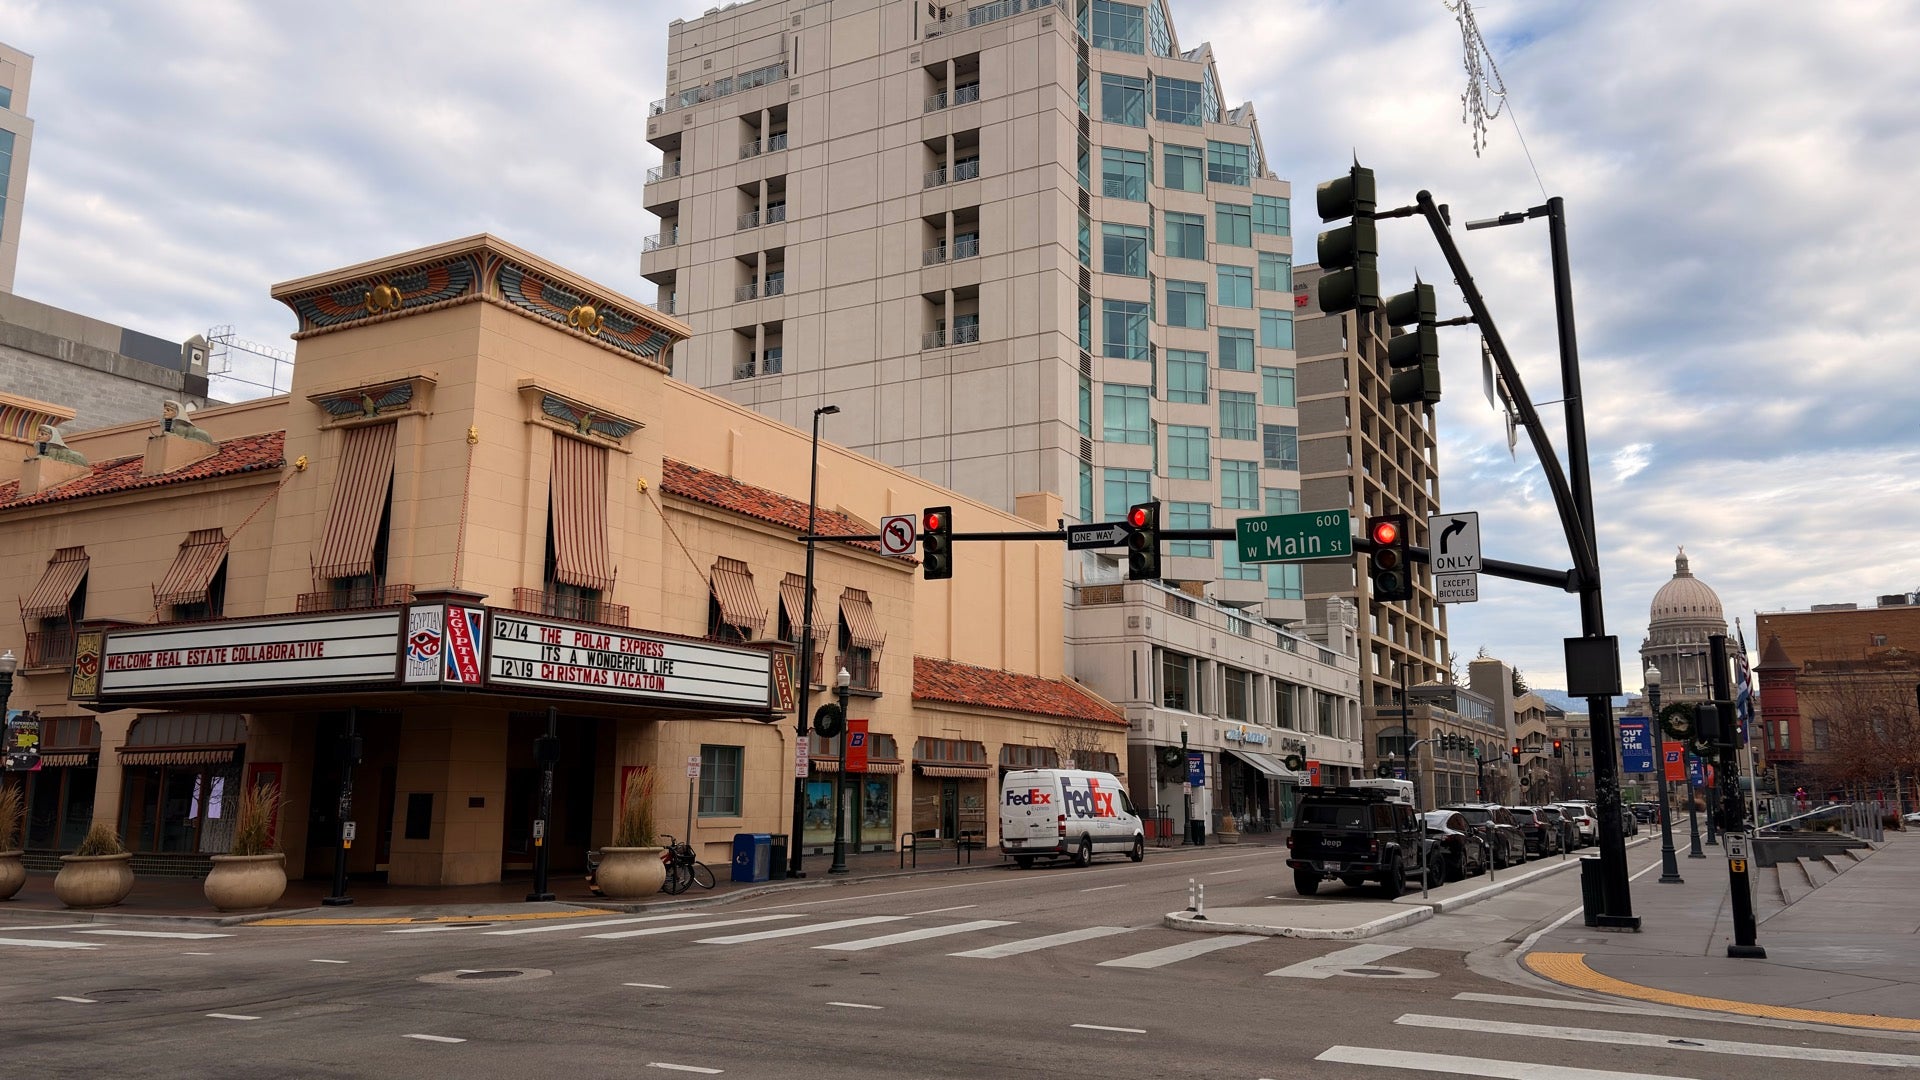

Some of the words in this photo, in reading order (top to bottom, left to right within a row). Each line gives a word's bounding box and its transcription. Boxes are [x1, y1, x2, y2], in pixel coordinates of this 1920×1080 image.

[1245, 521, 1268, 533] 700
[1316, 514, 1340, 527] 600
[1074, 532, 1092, 541] ONE
[1096, 530, 1114, 540] WAY
[1247, 546, 1257, 558] W
[1266, 531, 1321, 556] Main
[1330, 539, 1342, 552] St
[1437, 555, 1473, 569] ONLY
[1439, 588, 1475, 598] BICYCLES
[1442, 579, 1471, 588] EXCEPT
[409, 611, 441, 633] EGYPTIAN
[448, 608, 478, 682] EGYPTIAN
[495, 619, 528, 640] 12/14
[540, 627, 562, 644] THE
[574, 632, 610, 651] POLAR
[619, 638, 664, 657] EXPRESS
[107, 653, 152, 670] WELCOME
[156, 651, 181, 667] REAL
[187, 648, 227, 665] ESTATE
[231, 641, 324, 662] COLLABORATIVE
[541, 646, 561, 662] ITS
[570, 649, 578, 664] A
[587, 651, 648, 672] WONDERFUL
[653, 660, 674, 675] LIFE
[408, 657, 438, 676] THEATRE
[541, 663, 608, 685] CHRISTMAS
[613, 671, 665, 691] VACATOIN
[775, 653, 792, 709] EGYPTIAN
[850, 732, 865, 747] B
[1622, 729, 1642, 737] OUT
[1006, 788, 1051, 806] FedEx
[1060, 776, 1117, 819] FedEx
[1321, 839, 1342, 848] Jeep
